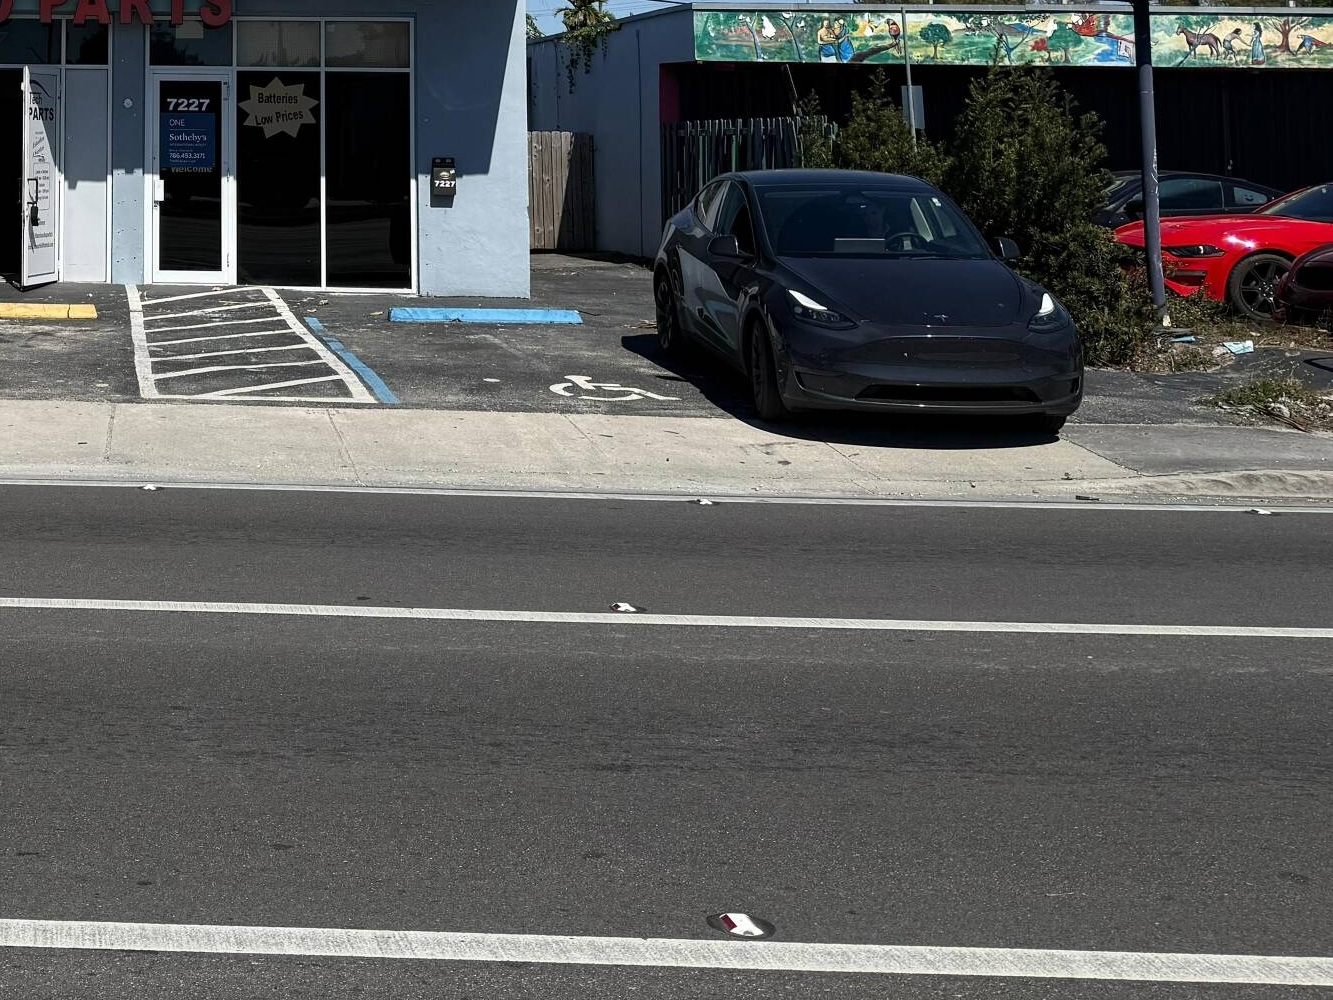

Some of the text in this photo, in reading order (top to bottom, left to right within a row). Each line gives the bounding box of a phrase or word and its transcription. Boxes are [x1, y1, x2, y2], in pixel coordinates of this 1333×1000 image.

[257, 92, 299, 104] Batteries
[167, 98, 211, 111] 7227
[29, 106, 54, 120] PARTS
[254, 110, 304, 126] Low Prices
[169, 132, 207, 142] Sotheby's
[434, 180, 456, 188] 7227
